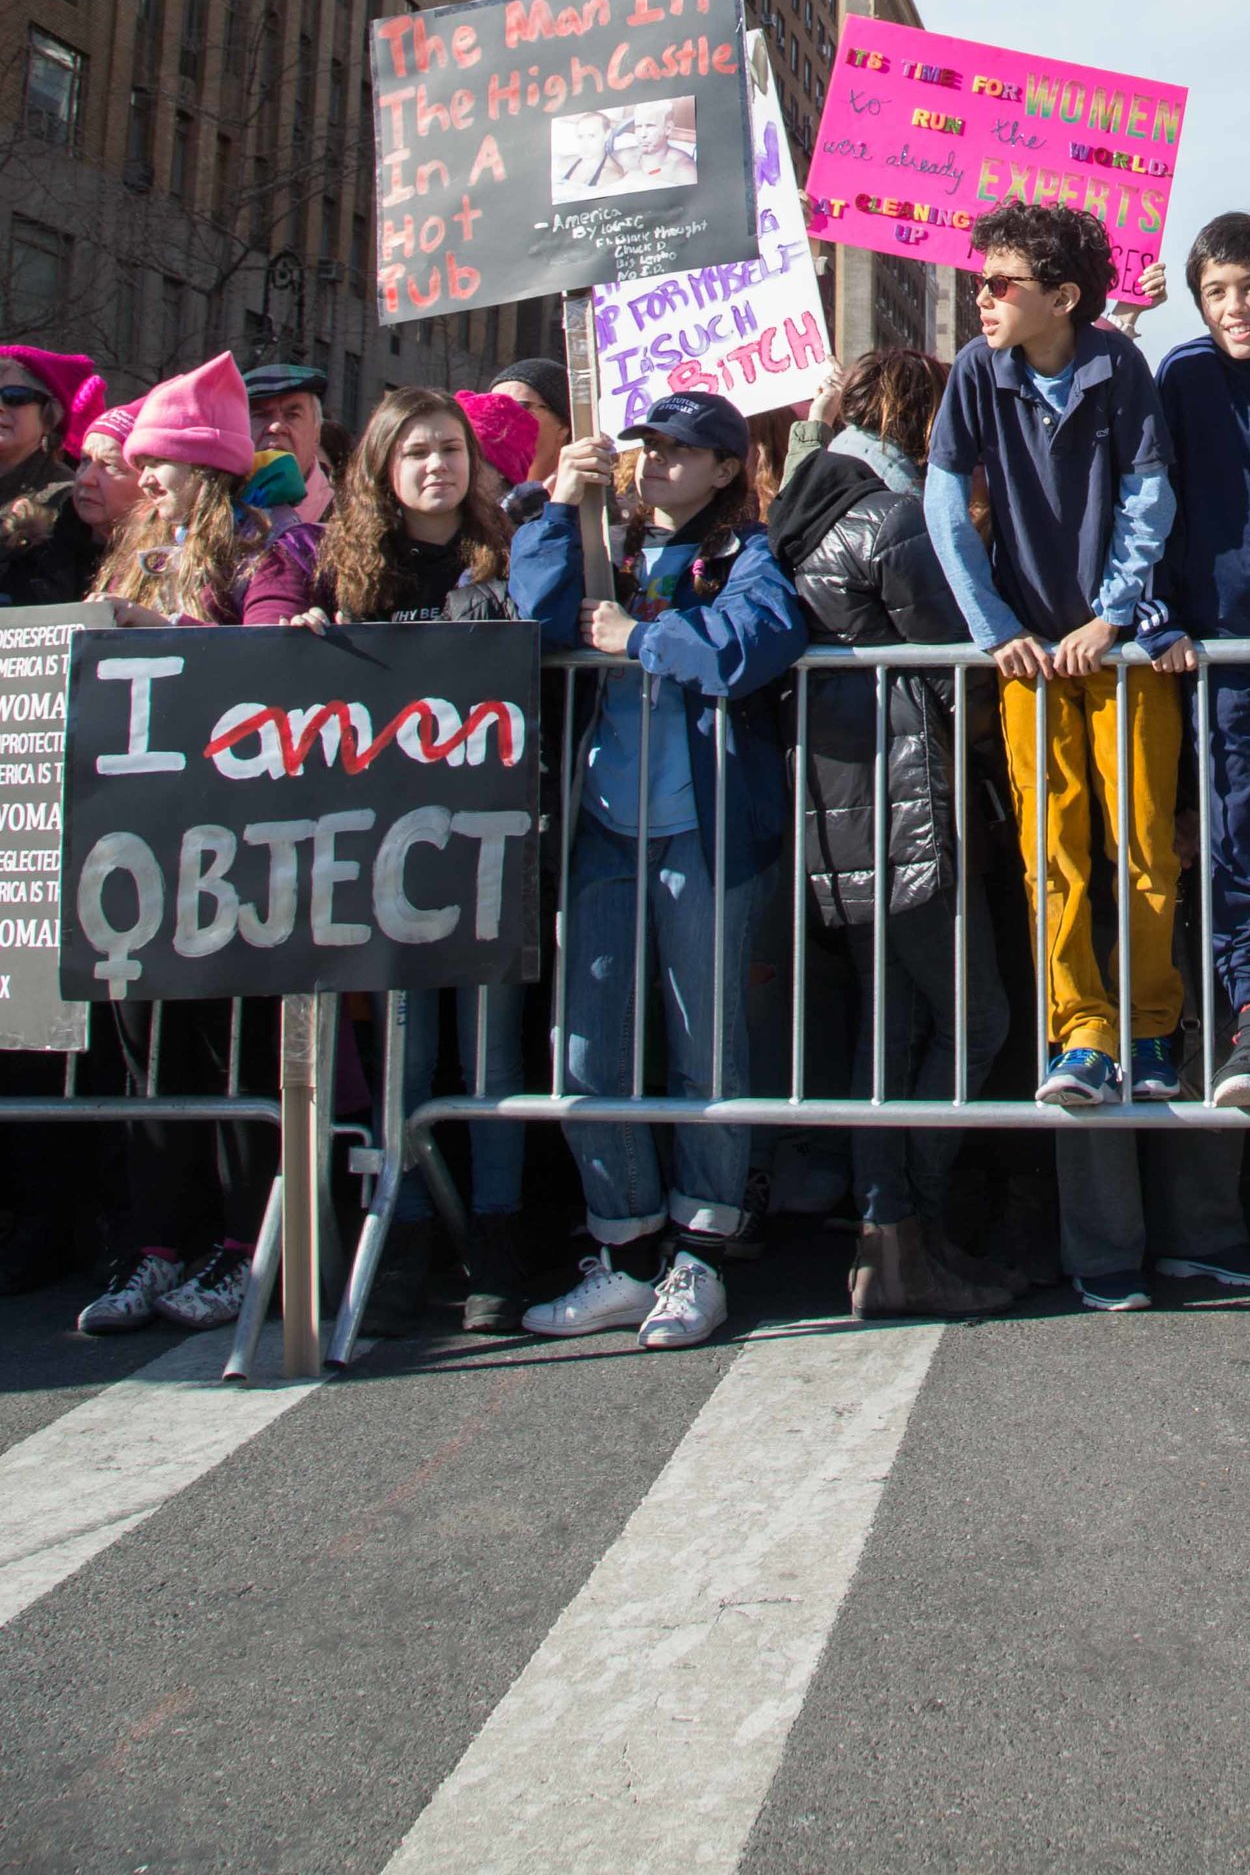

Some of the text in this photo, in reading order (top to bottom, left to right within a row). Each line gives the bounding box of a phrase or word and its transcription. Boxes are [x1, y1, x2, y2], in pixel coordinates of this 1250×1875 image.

[378, 13, 481, 78] The
[379, 36, 739, 151] The High Castle
[845, 47, 1183, 145] ITS TIME FOR WOMEN
[848, 88, 893, 115] to
[911, 108, 965, 135] RUN
[991, 118, 1047, 150] the
[381, 134, 508, 209] In A
[886, 143, 964, 196] already
[976, 156, 1166, 234] EXPERTS
[381, 193, 484, 262] Hot
[553, 208, 621, 233] America
[814, 193, 971, 229] AT CLEANING
[895, 224, 926, 243] UP
[656, 241, 667, 252] D
[377, 250, 483, 313] Tub
[627, 280, 690, 332] FOR
[650, 300, 759, 372] SUCH
[45, 654, 59, 676] IS
[0, 691, 67, 722] WOMA
[96, 656, 187, 775] I
[38, 762, 51, 784] IS
[30, 881, 44, 902] IS
[77, 805, 533, 1001] OBJECT
